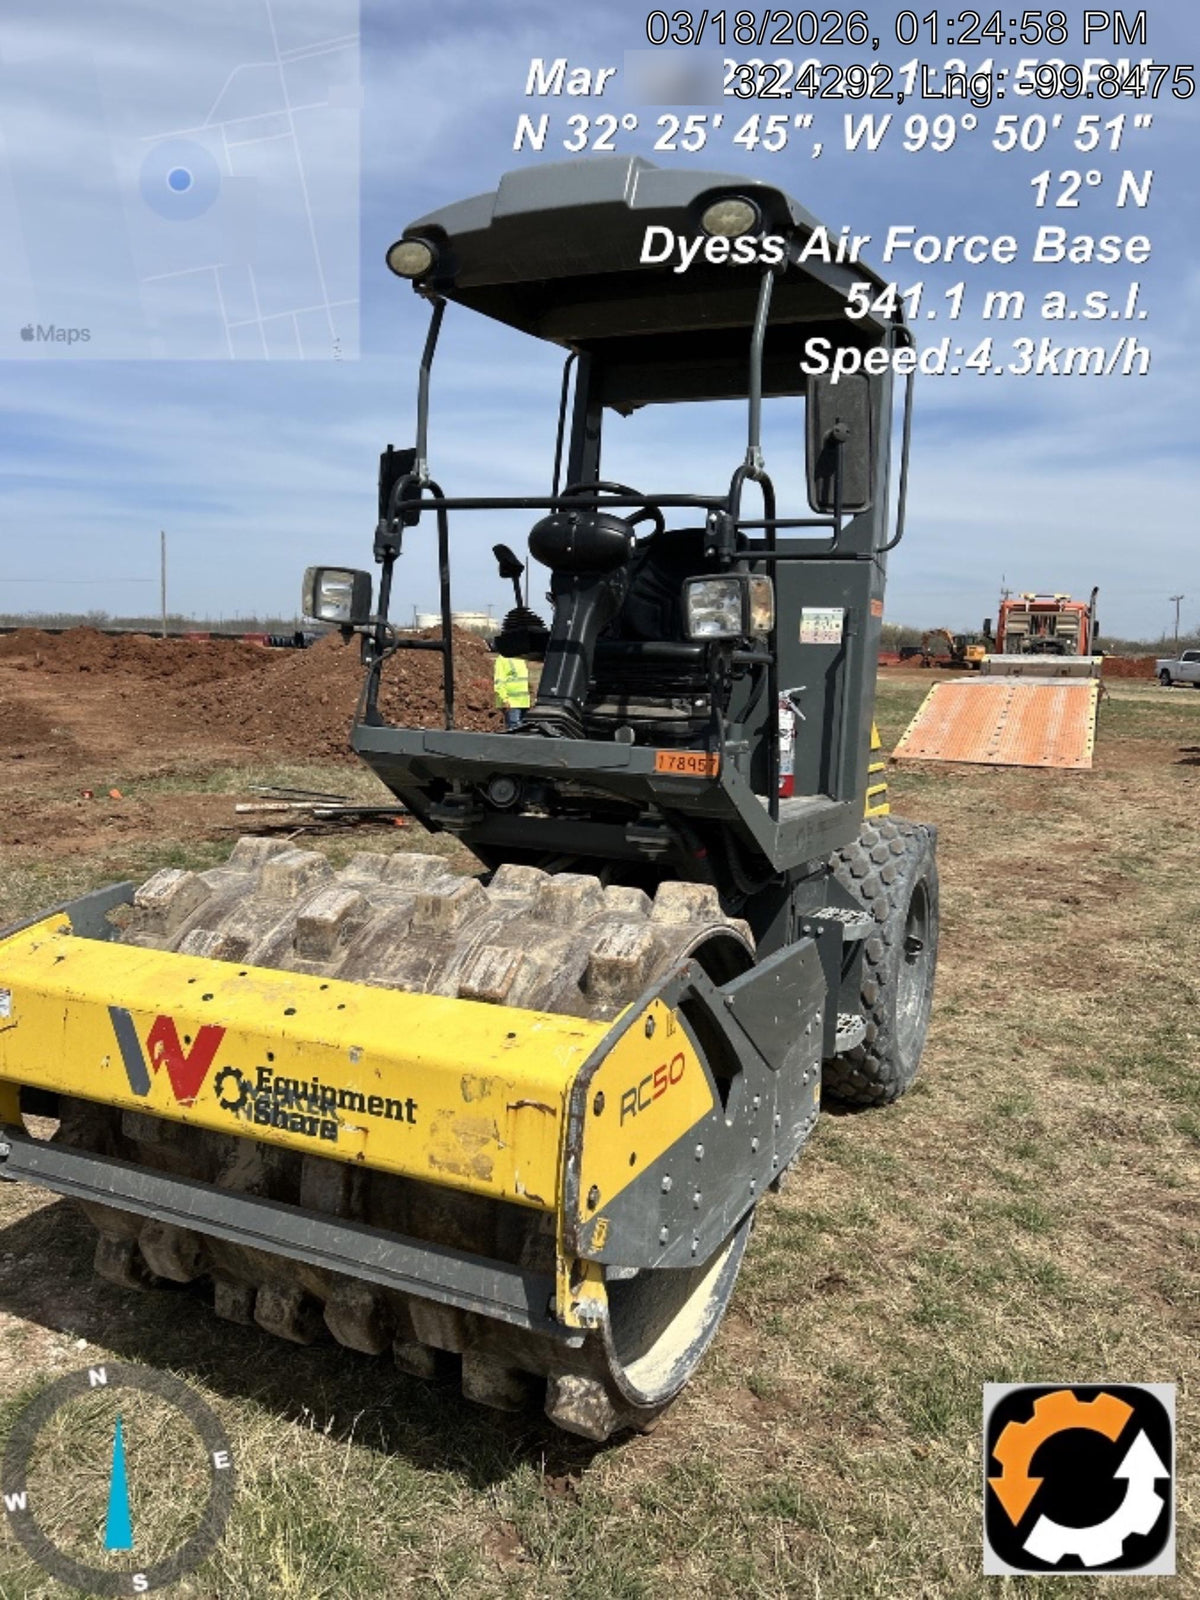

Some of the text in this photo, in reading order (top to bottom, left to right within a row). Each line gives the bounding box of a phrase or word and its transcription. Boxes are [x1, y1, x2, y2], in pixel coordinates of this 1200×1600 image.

[658, 754, 717, 773] 178957
[256, 1066, 418, 1124] Equipment
[620, 1051, 686, 1128] RC50
[254, 1100, 338, 1141] Share
